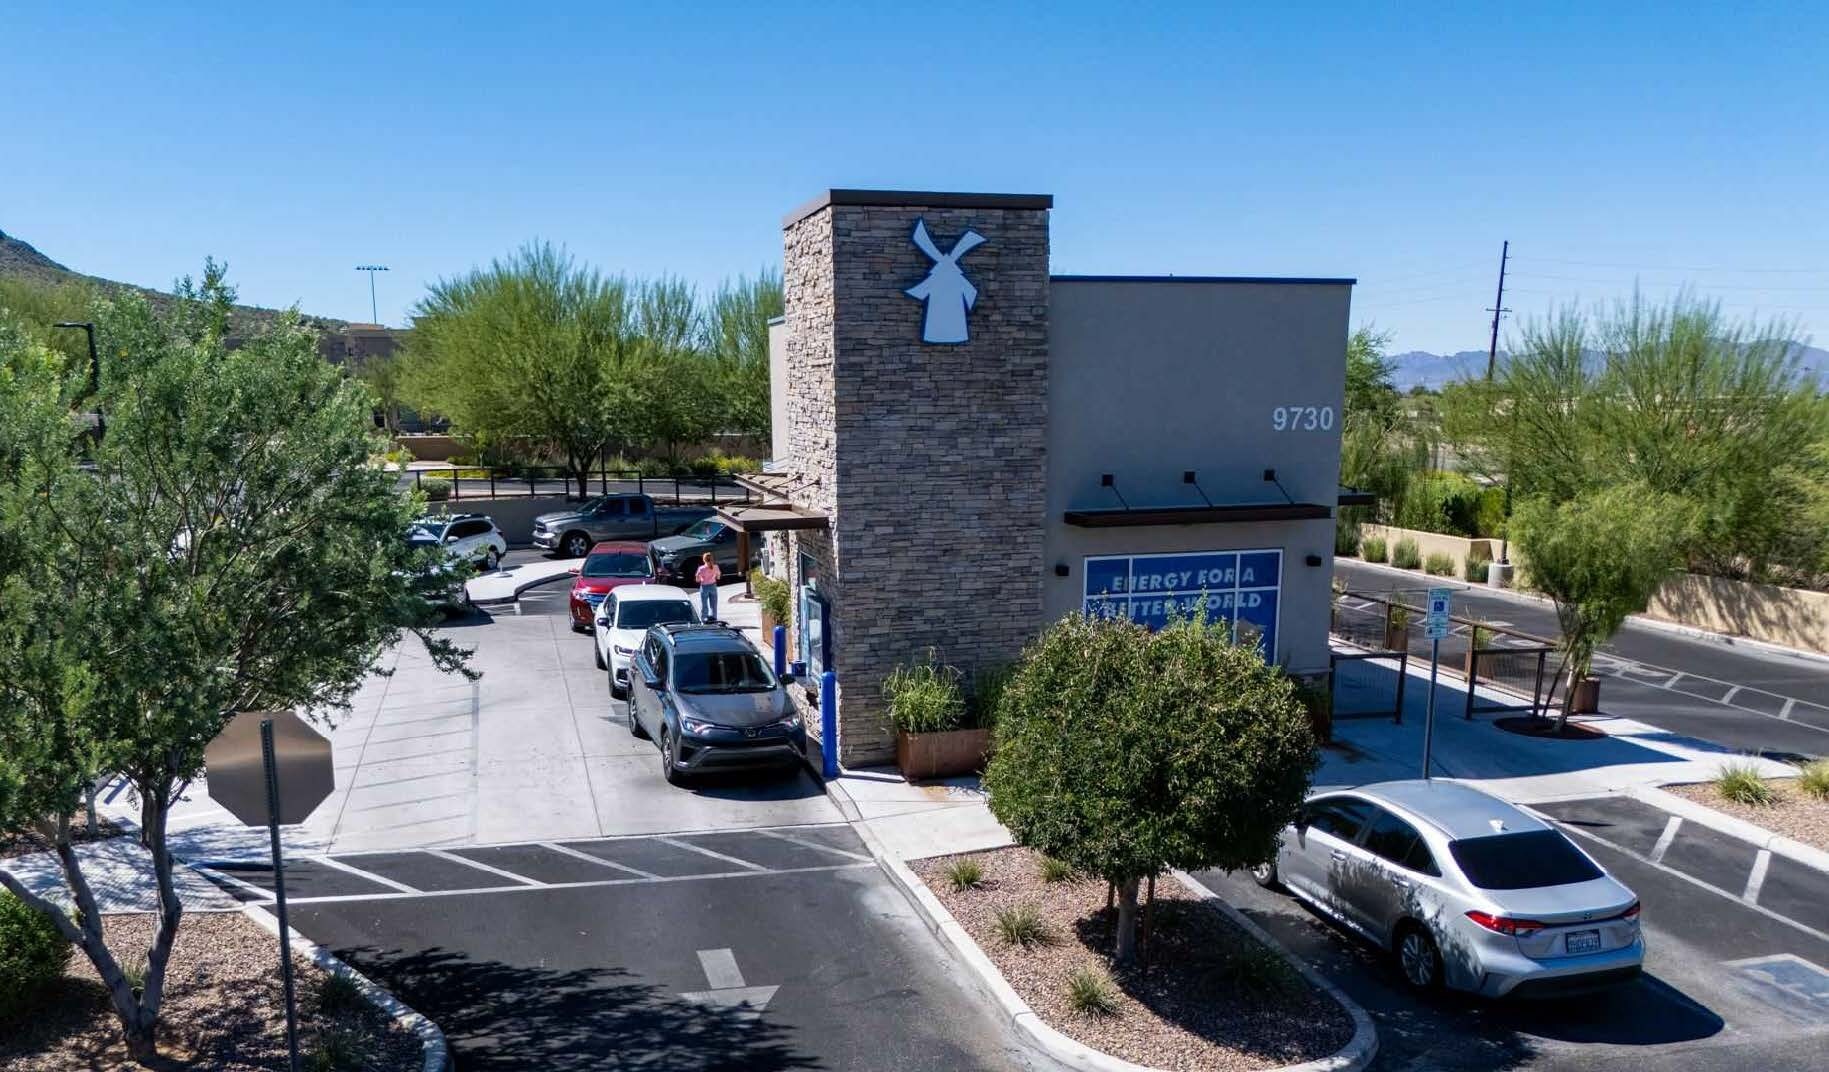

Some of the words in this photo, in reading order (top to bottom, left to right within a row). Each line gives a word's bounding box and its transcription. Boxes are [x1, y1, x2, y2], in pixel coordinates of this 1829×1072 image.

[1273, 407, 1334, 431] 9730
[1111, 570, 1192, 592] ENERGY
[1198, 567, 1236, 585] FOR
[1242, 567, 1255, 583] A
